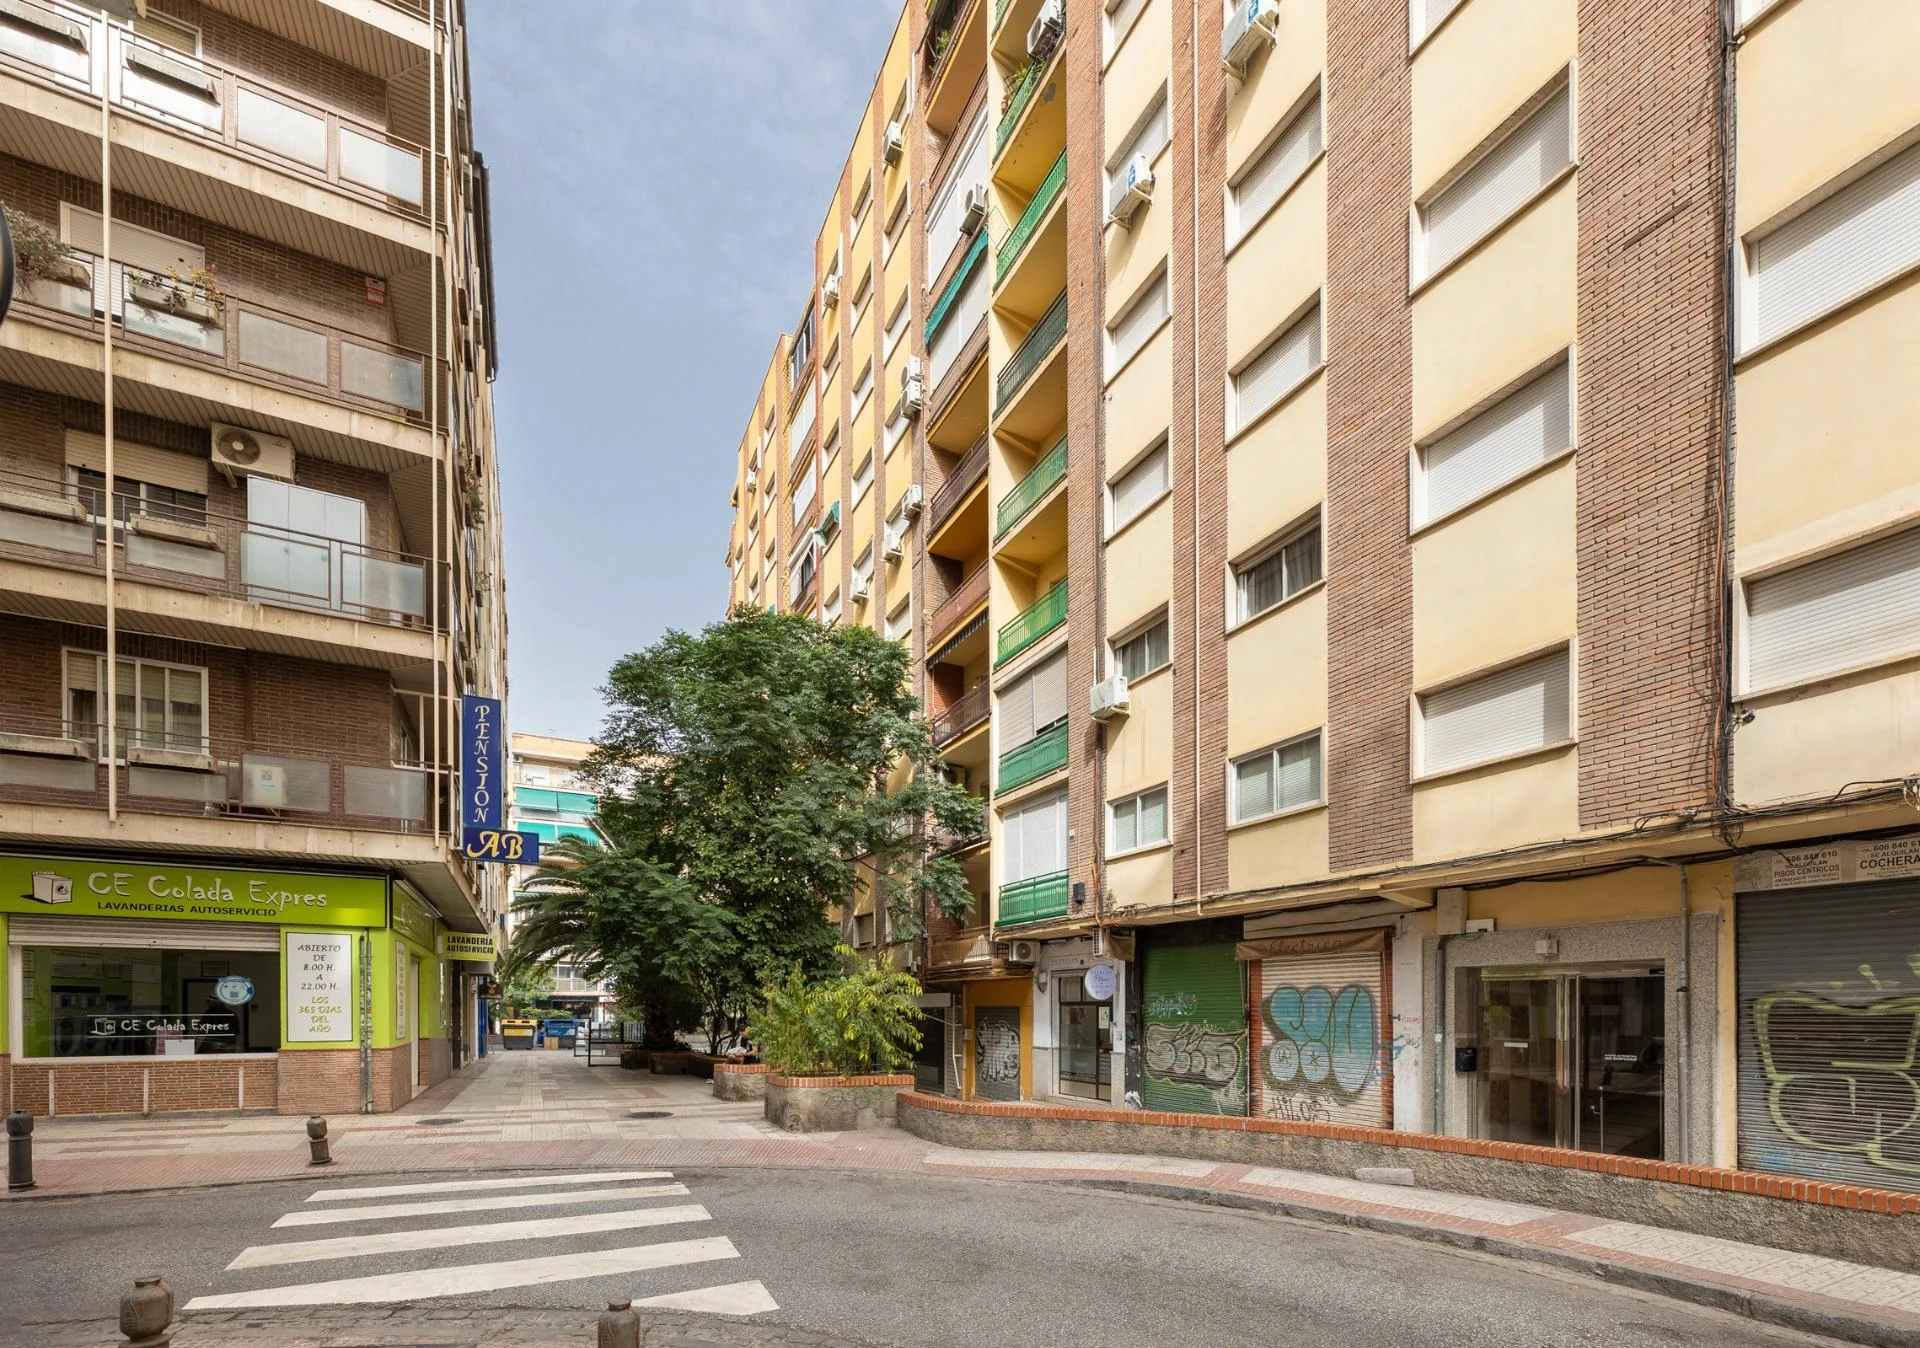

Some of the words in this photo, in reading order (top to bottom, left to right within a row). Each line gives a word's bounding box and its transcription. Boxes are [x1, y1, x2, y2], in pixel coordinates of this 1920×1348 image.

[474, 705, 490, 823] PENSION
[466, 830, 523, 860] AB
[1774, 869, 1796, 878] PISOS
[88, 872, 134, 896] CE
[148, 874, 234, 903] Colada
[248, 879, 328, 912] Expres
[97, 901, 184, 914] LAVANDERIAS
[190, 905, 276, 917] AUTOSERVICIO
[447, 935, 493, 946] LAVANDERÍA
[297, 944, 341, 953] ABIERTO
[446, 945, 494, 955] AUTOSERVICIO
[312, 954, 327, 962] DE
[303, 963, 324, 971] 8.00
[316, 973, 323, 981] A
[300, 983, 327, 991] 22.00
[311, 996, 329, 1004] LOS
[298, 1006, 316, 1014] 365
[310, 1015, 329, 1024] DEL
[121, 1020, 141, 1031] CE
[146, 1019, 186, 1031] Colada
[191, 1020, 230, 1034] Expres
